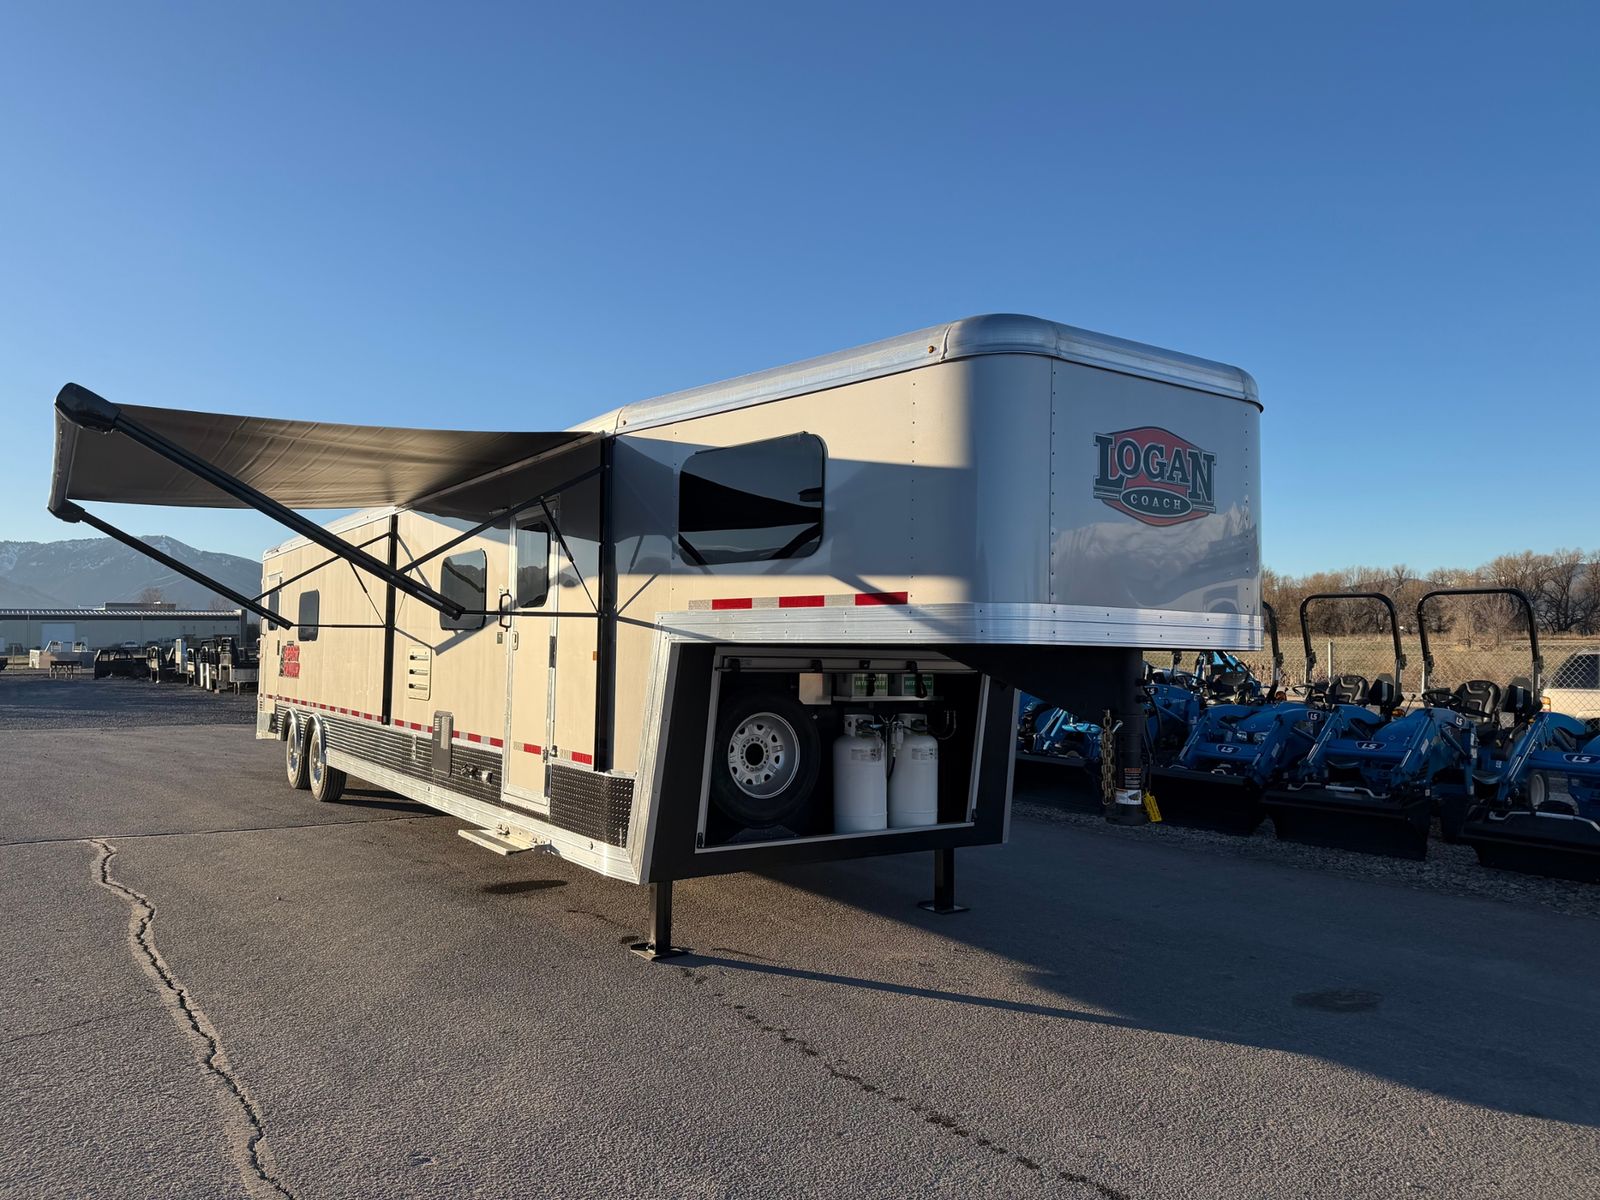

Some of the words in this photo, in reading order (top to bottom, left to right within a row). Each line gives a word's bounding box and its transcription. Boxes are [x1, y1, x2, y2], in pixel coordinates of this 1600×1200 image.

[1094, 433, 1216, 504] LOGAN
[1130, 494, 1181, 509] COACH
[1456, 717, 1463, 725] LS
